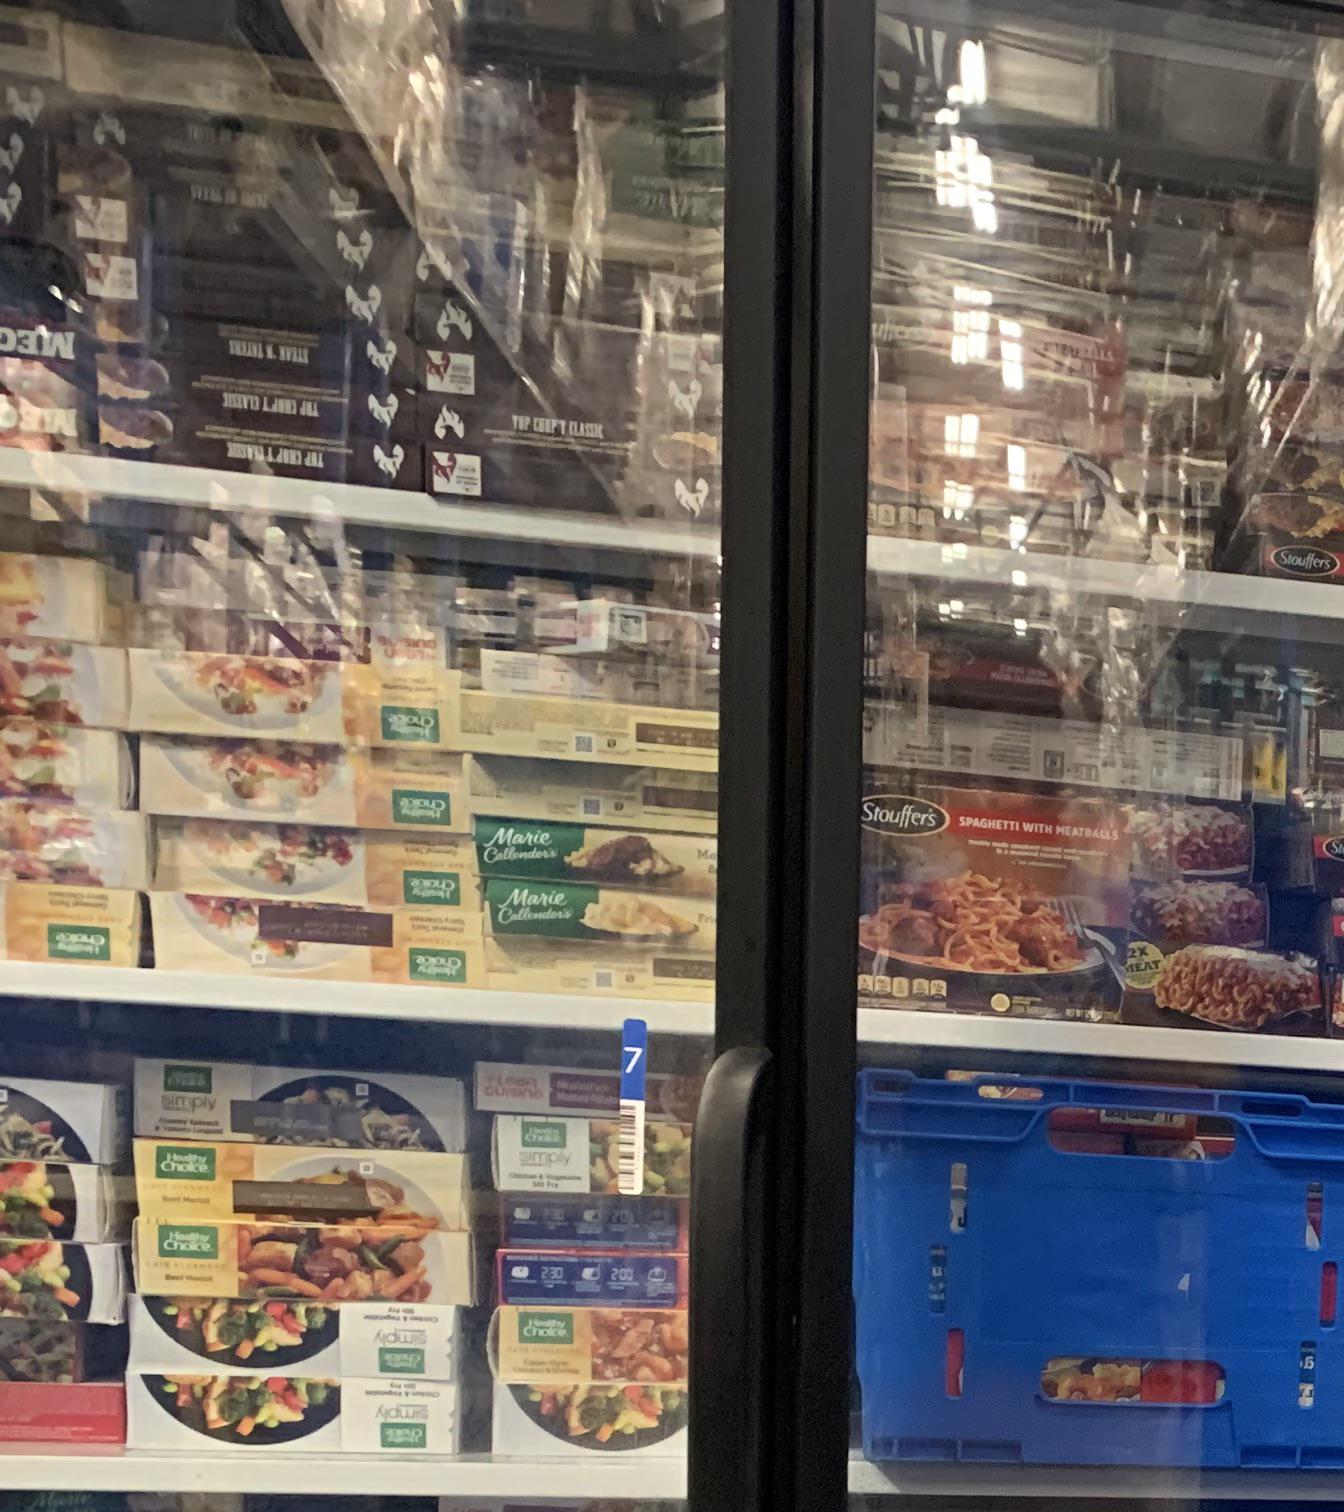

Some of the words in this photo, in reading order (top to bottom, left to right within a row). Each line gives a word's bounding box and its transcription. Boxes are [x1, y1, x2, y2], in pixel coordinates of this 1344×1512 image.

[487, 828, 552, 846] Marie
[959, 816, 1020, 831] SPAGHETTI
[1023, 822, 1053, 834] WITH
[1056, 825, 1120, 841] MEATBALLS
[483, 848, 558, 863] Callender's
[501, 888, 567, 907] Marie
[498, 907, 573, 925] Callender's
[624, 1047, 643, 1074] 7
[373, 1329, 426, 1345] simply
[375, 1404, 429, 1421] simply
